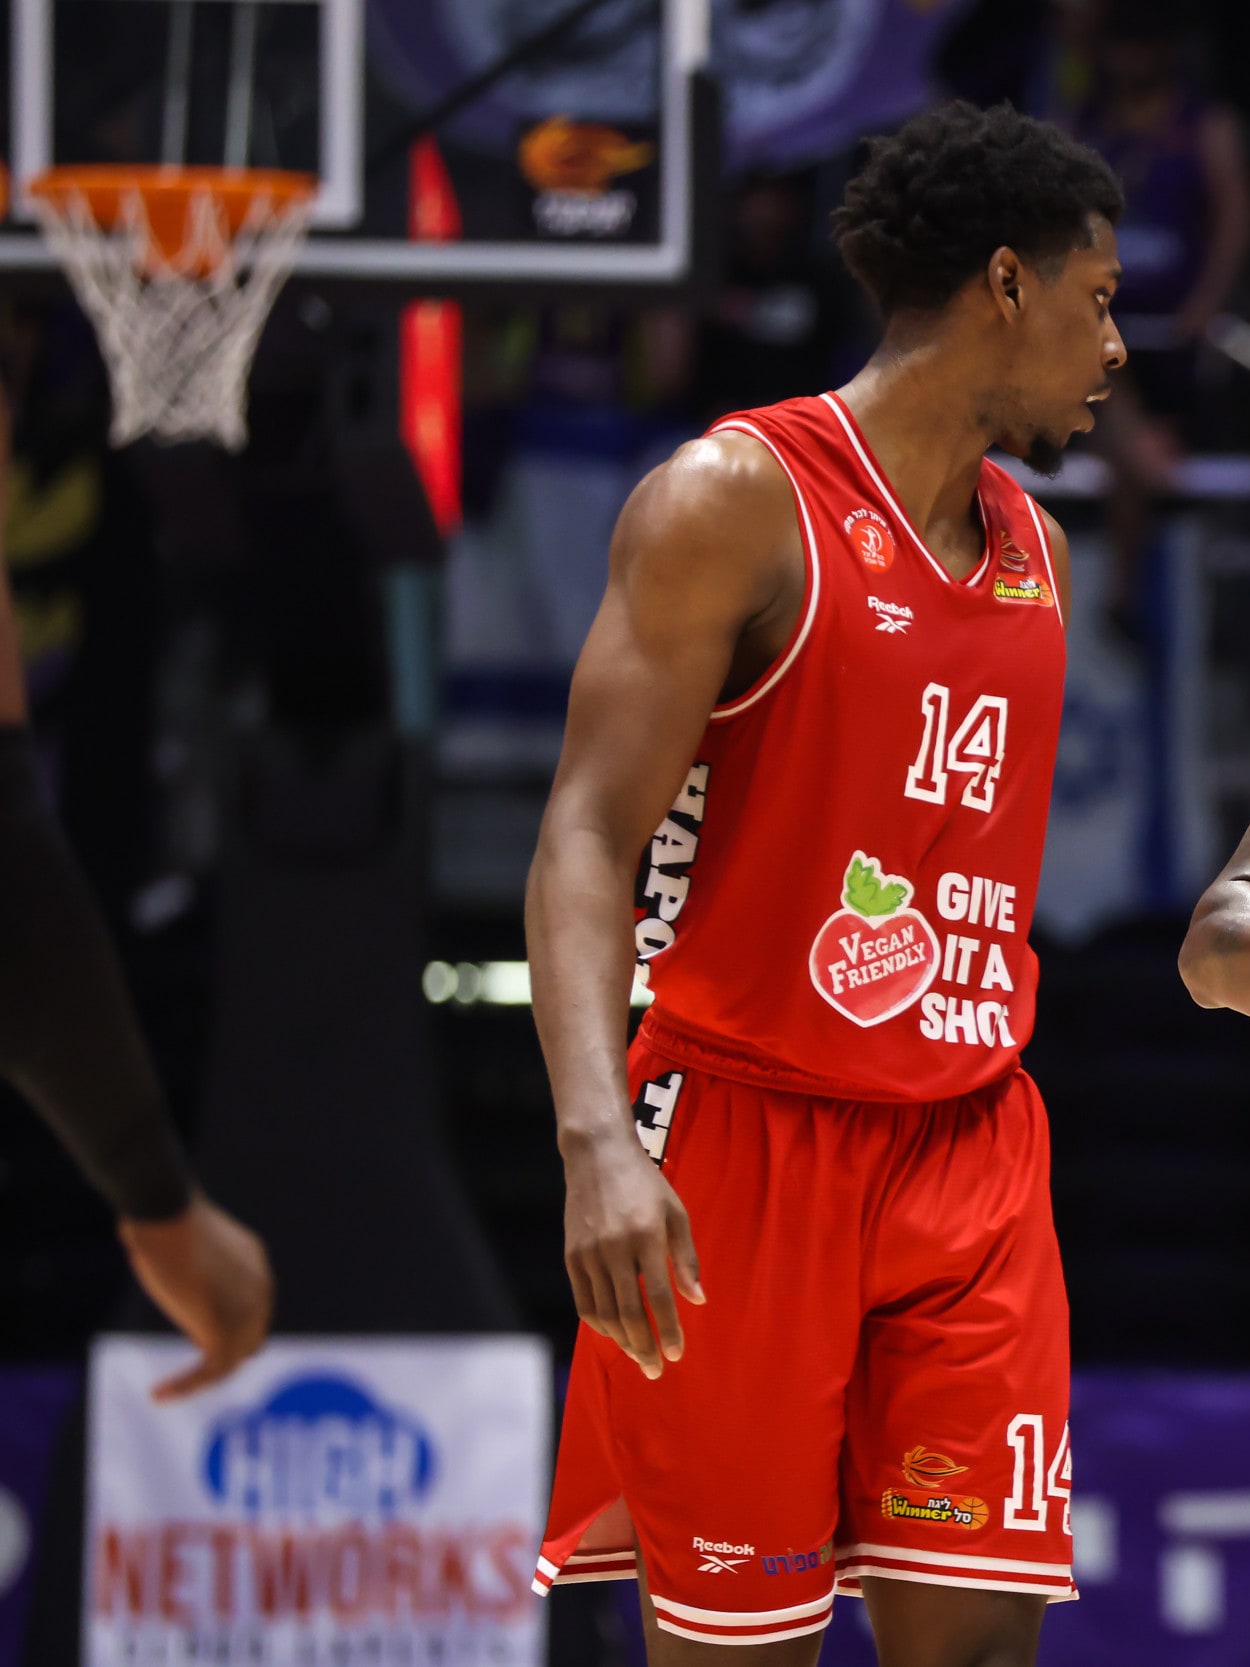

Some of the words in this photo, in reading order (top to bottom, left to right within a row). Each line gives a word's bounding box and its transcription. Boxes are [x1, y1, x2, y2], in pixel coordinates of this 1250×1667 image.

[867, 596, 914, 620] Reebok
[996, 581, 1040, 598] Winner
[904, 682, 1008, 814] 14
[936, 871, 1017, 933] GIVE
[942, 933, 980, 986] IT
[980, 943, 1015, 993] A
[919, 992, 1017, 1049] SHOT
[220, 1412, 424, 1516] HIGH
[892, 1497, 953, 1521] Winner
[953, 1508, 972, 1524] סל
[96, 1518, 533, 1628] NETWORKS
[692, 1536, 755, 1557] Reebok
